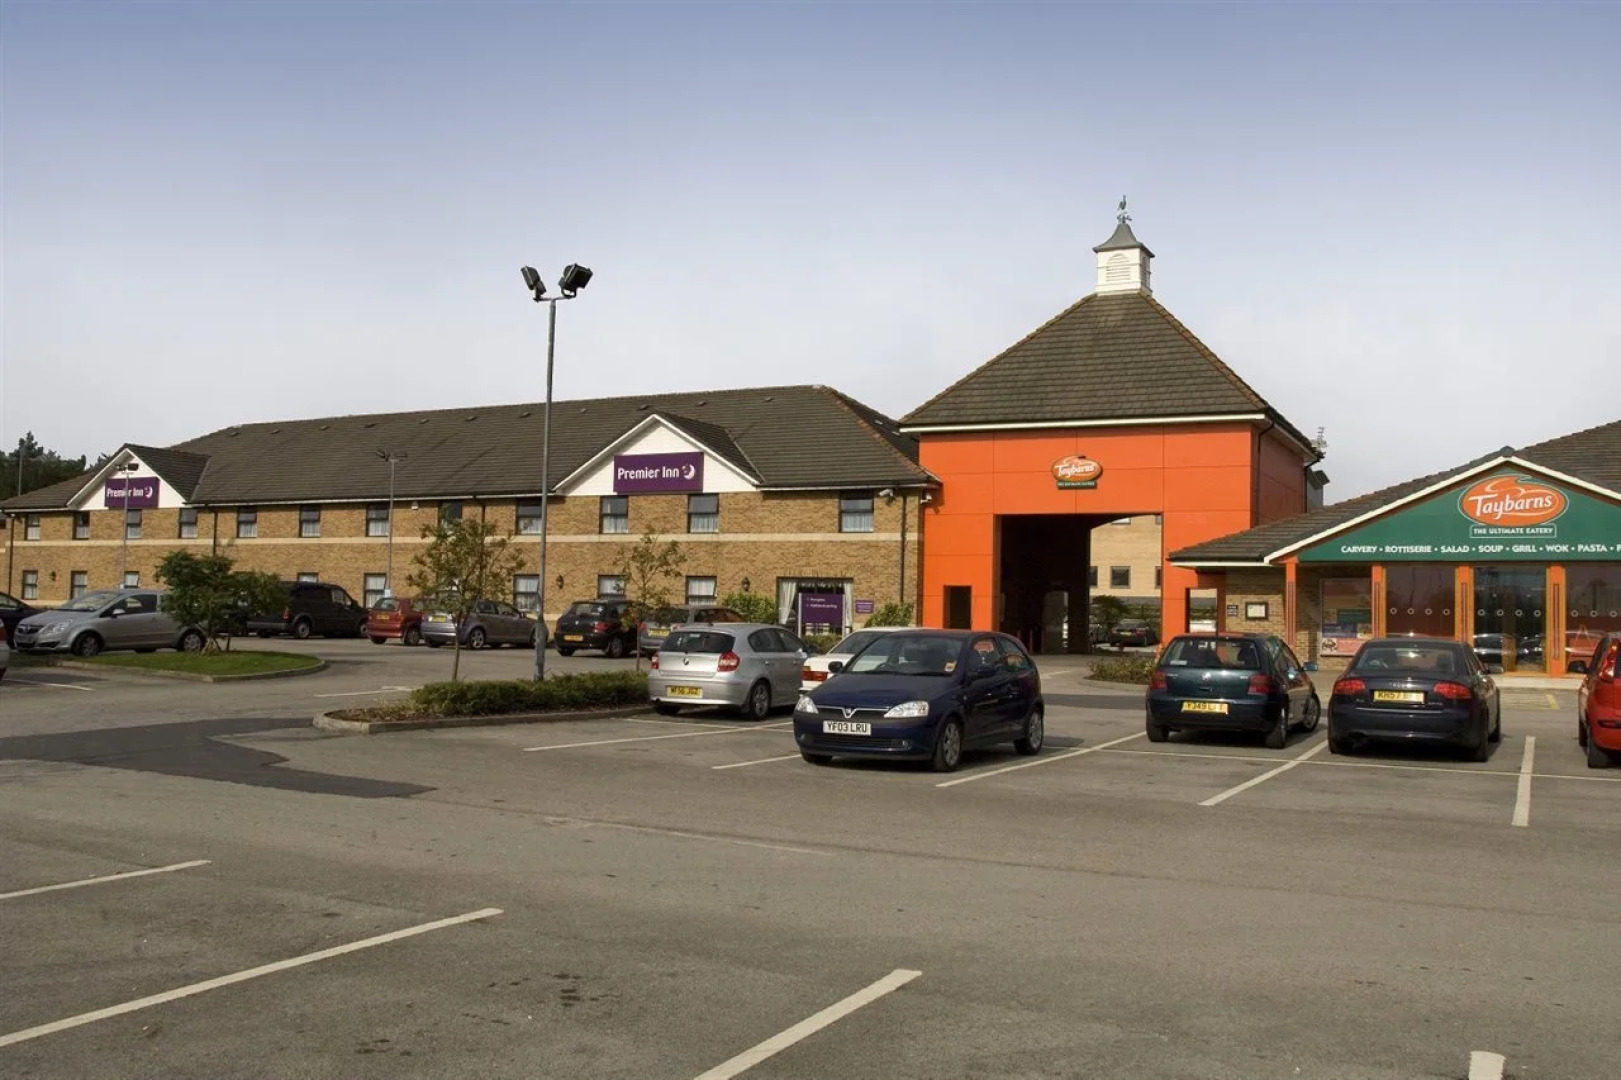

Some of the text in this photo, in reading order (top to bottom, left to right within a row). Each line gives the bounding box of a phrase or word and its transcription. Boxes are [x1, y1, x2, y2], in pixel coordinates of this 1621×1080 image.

[617, 466, 680, 480] Premier Inn
[1054, 464, 1094, 478] Taybarns
[1468, 493, 1553, 520] Taybarns
[1440, 545, 1470, 553] SALAD
[1478, 544, 1504, 552] SOUP
[1512, 544, 1537, 552] GRILL
[1545, 544, 1569, 552] WOK
[1578, 544, 1608, 552] PASTA
[827, 722, 866, 733] YF03 LRU
